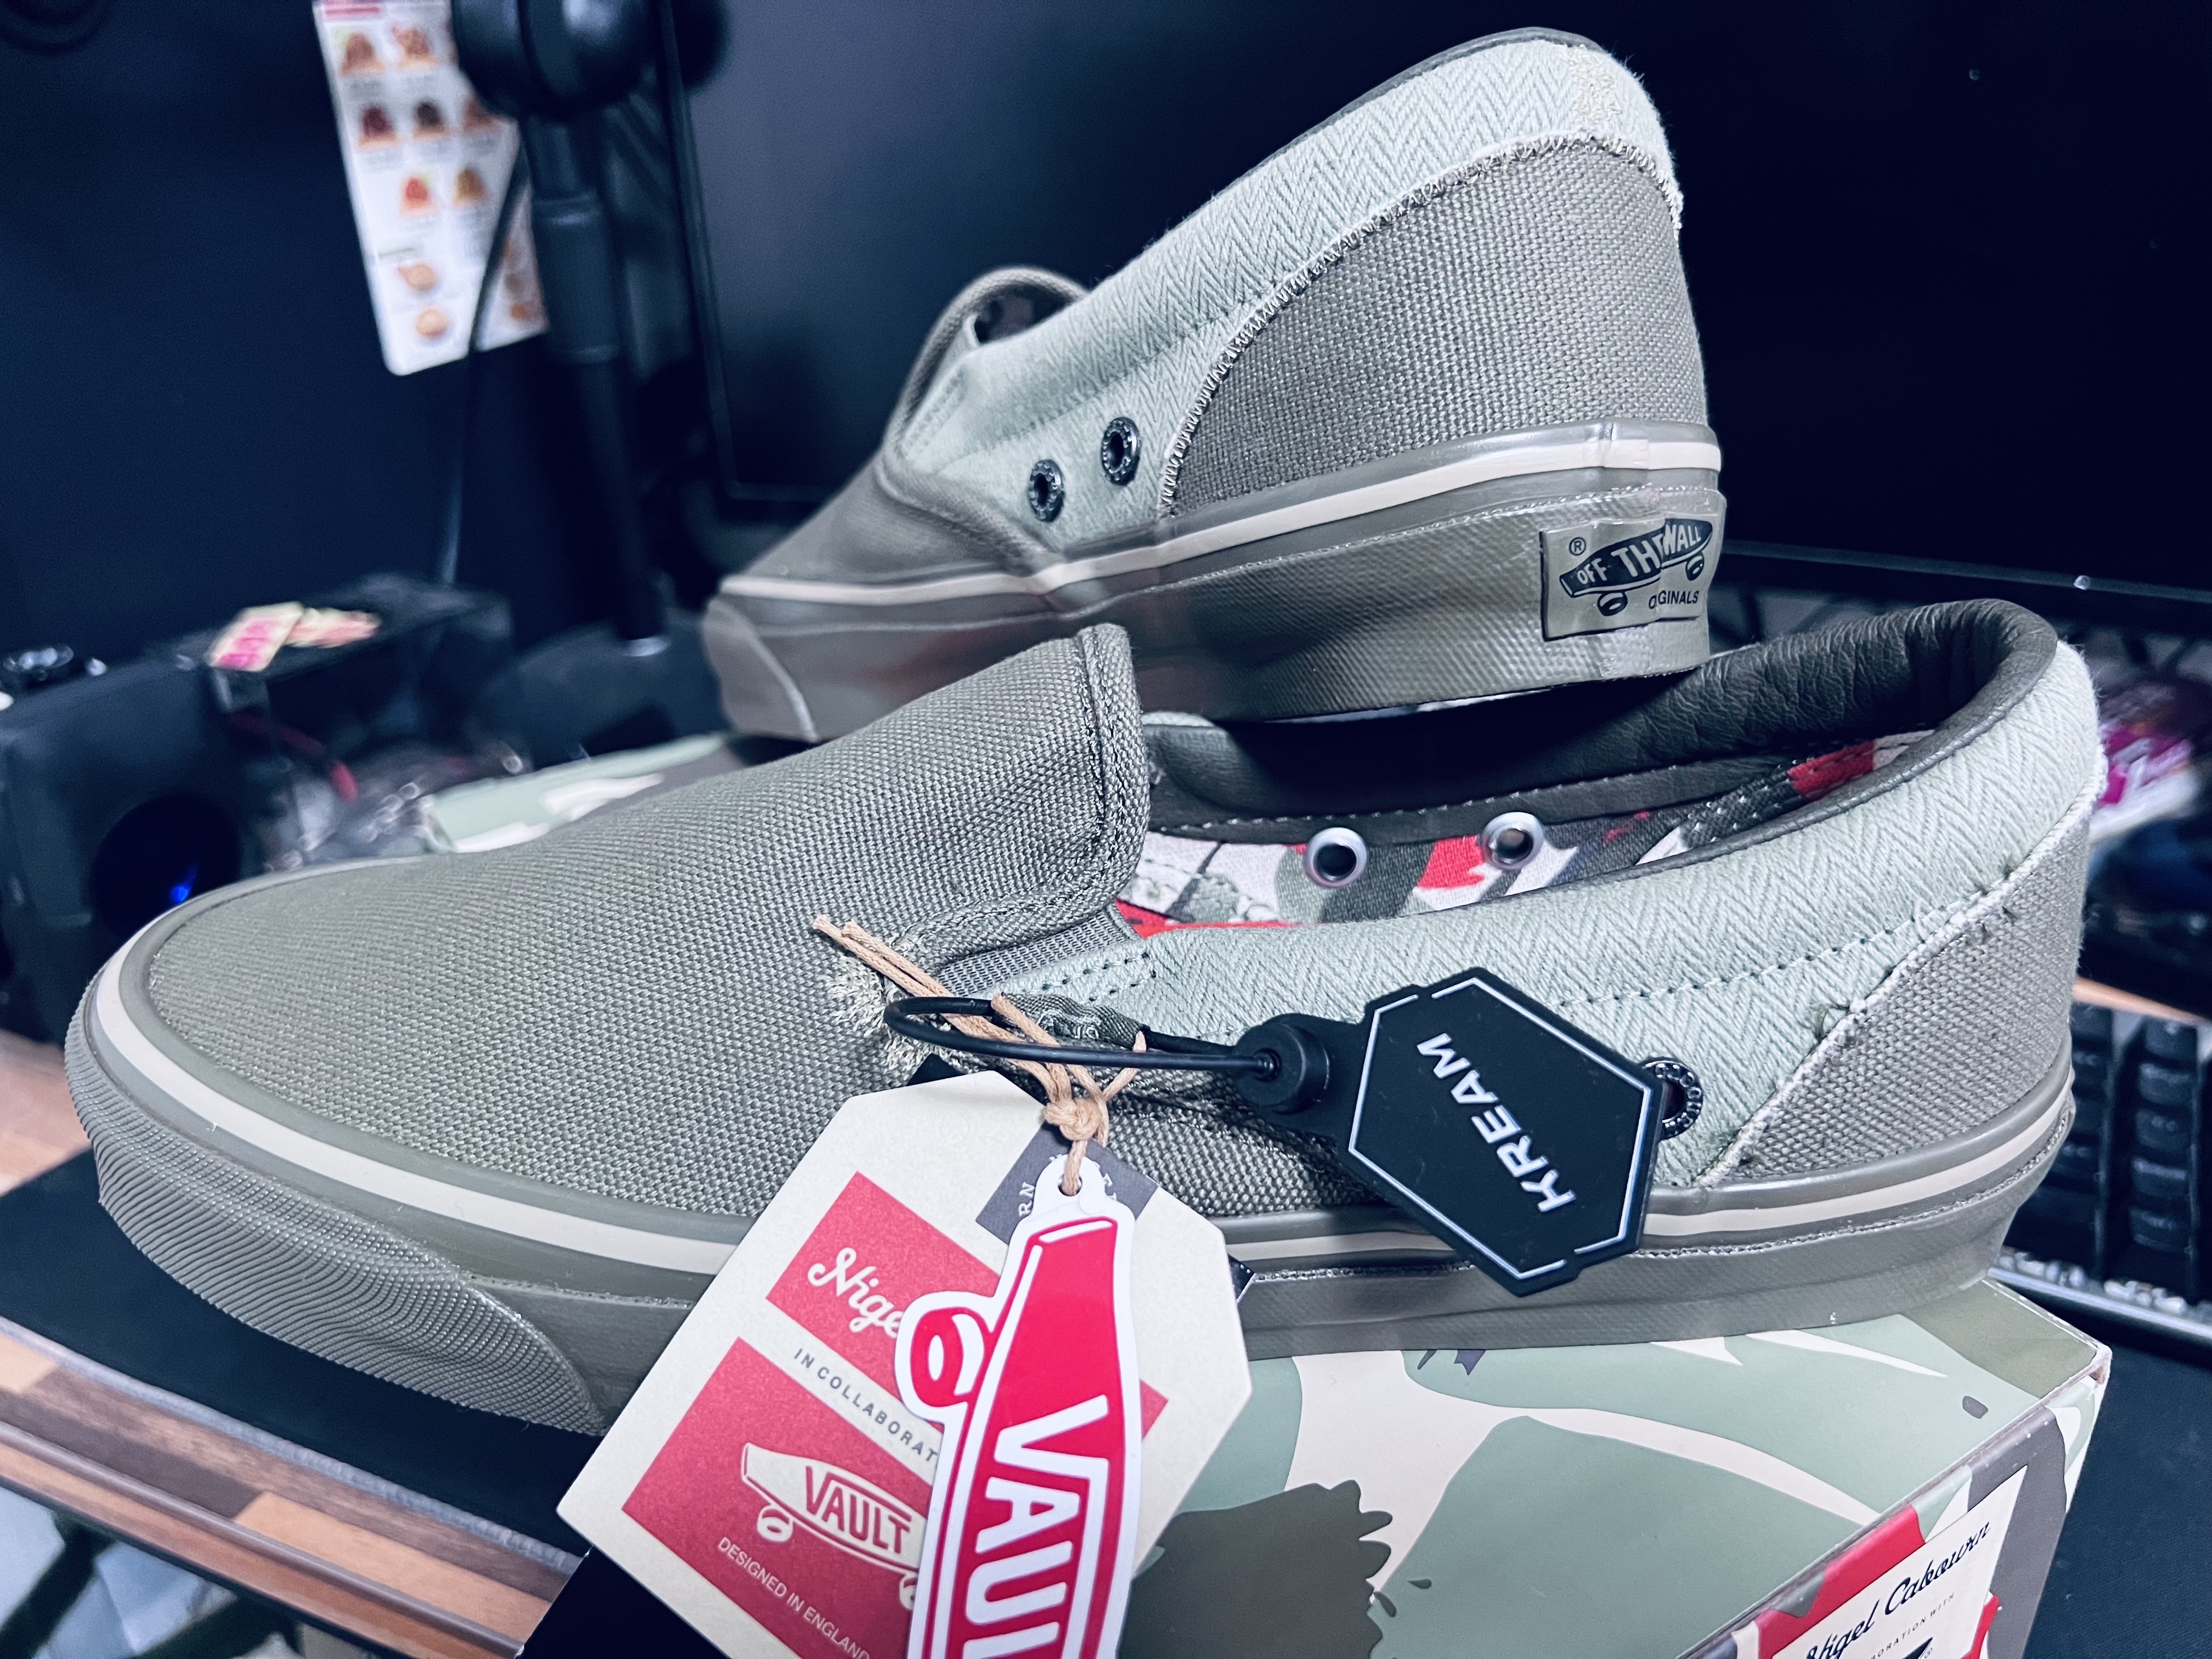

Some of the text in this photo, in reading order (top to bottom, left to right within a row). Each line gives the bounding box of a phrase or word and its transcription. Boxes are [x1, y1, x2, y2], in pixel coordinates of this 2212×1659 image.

[1577, 557, 1607, 585] OFF
[1663, 524, 1701, 556] WALL
[1417, 1033, 1576, 1212] KREAM
[807, 1246, 905, 1339] Nige
[793, 1347, 939, 1462] IN COLLABORAT
[805, 1465, 912, 1554] VAULT
[961, 1395, 1110, 1659] VAUL
[717, 1536, 787, 1598] DESIGNED
[787, 1592, 805, 1612] IN
[1870, 1616, 1927, 1659] ORATION
